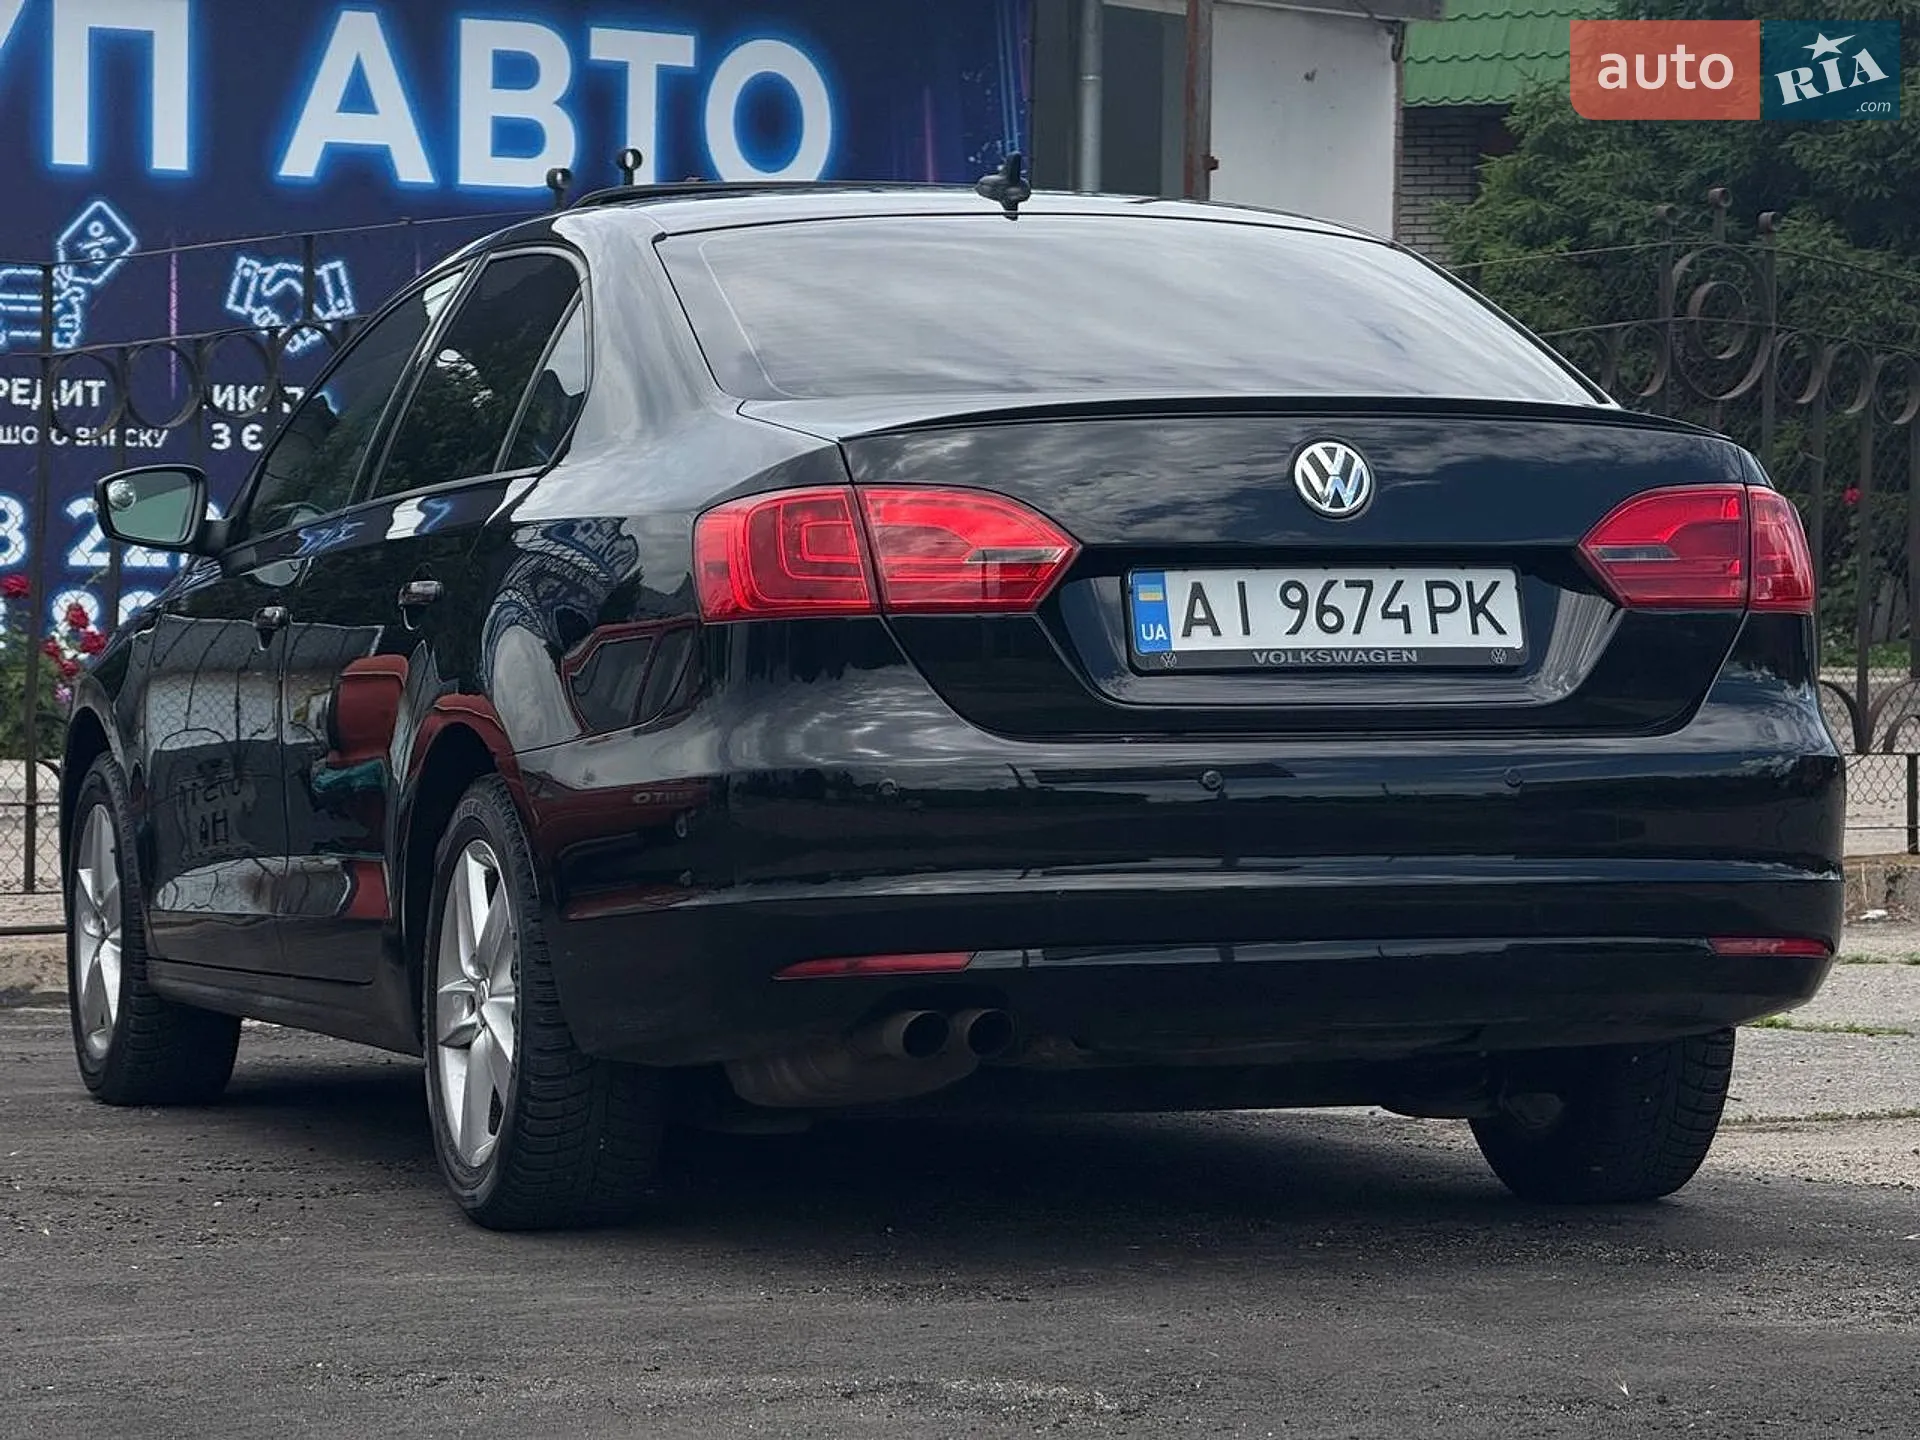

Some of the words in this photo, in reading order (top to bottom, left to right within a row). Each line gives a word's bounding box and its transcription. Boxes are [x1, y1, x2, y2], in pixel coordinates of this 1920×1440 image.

[278, 10, 832, 188] АВТО
[1142, 624, 1168, 641] UA
[1252, 649, 1419, 666] VOLKSWAGEN
